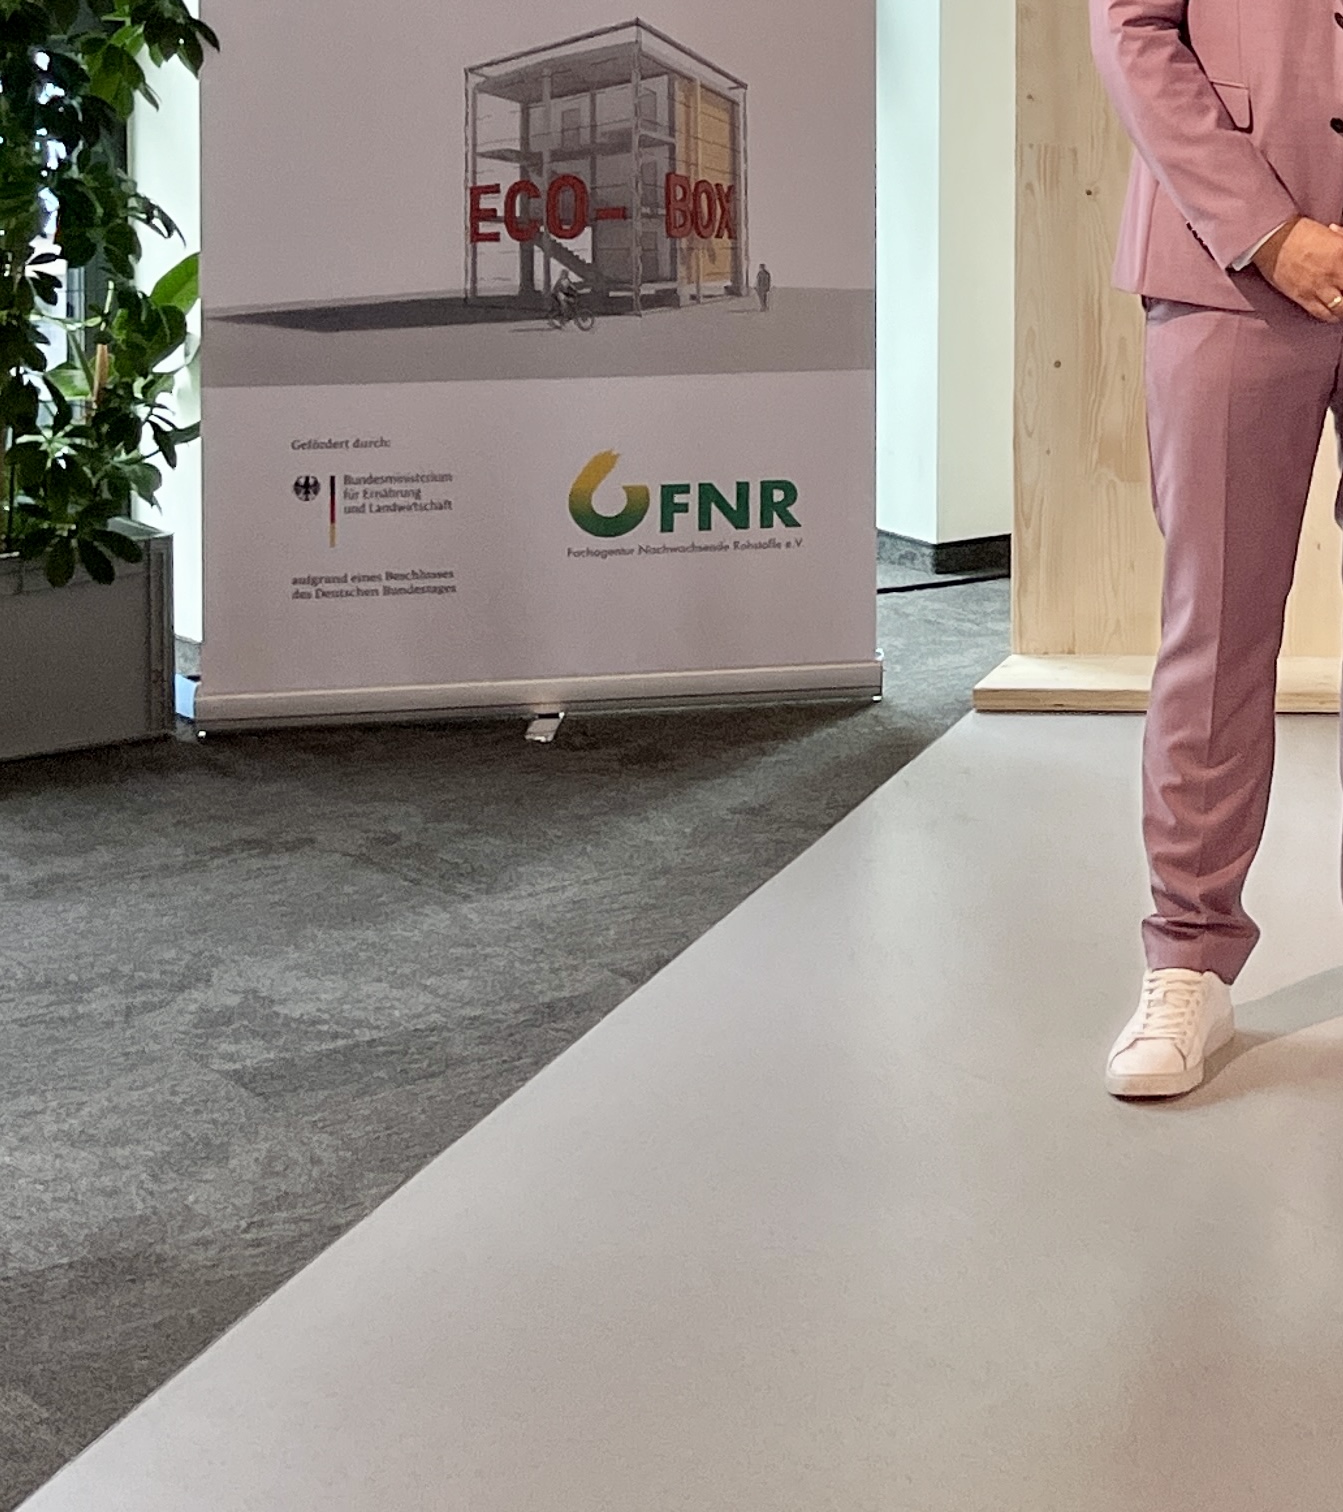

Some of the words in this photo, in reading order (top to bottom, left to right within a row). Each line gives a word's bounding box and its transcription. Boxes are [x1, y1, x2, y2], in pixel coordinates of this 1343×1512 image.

[664, 171, 738, 240] BOX
[291, 438, 350, 451] Gefördert
[343, 503, 365, 515] und
[659, 479, 803, 534] FNR
